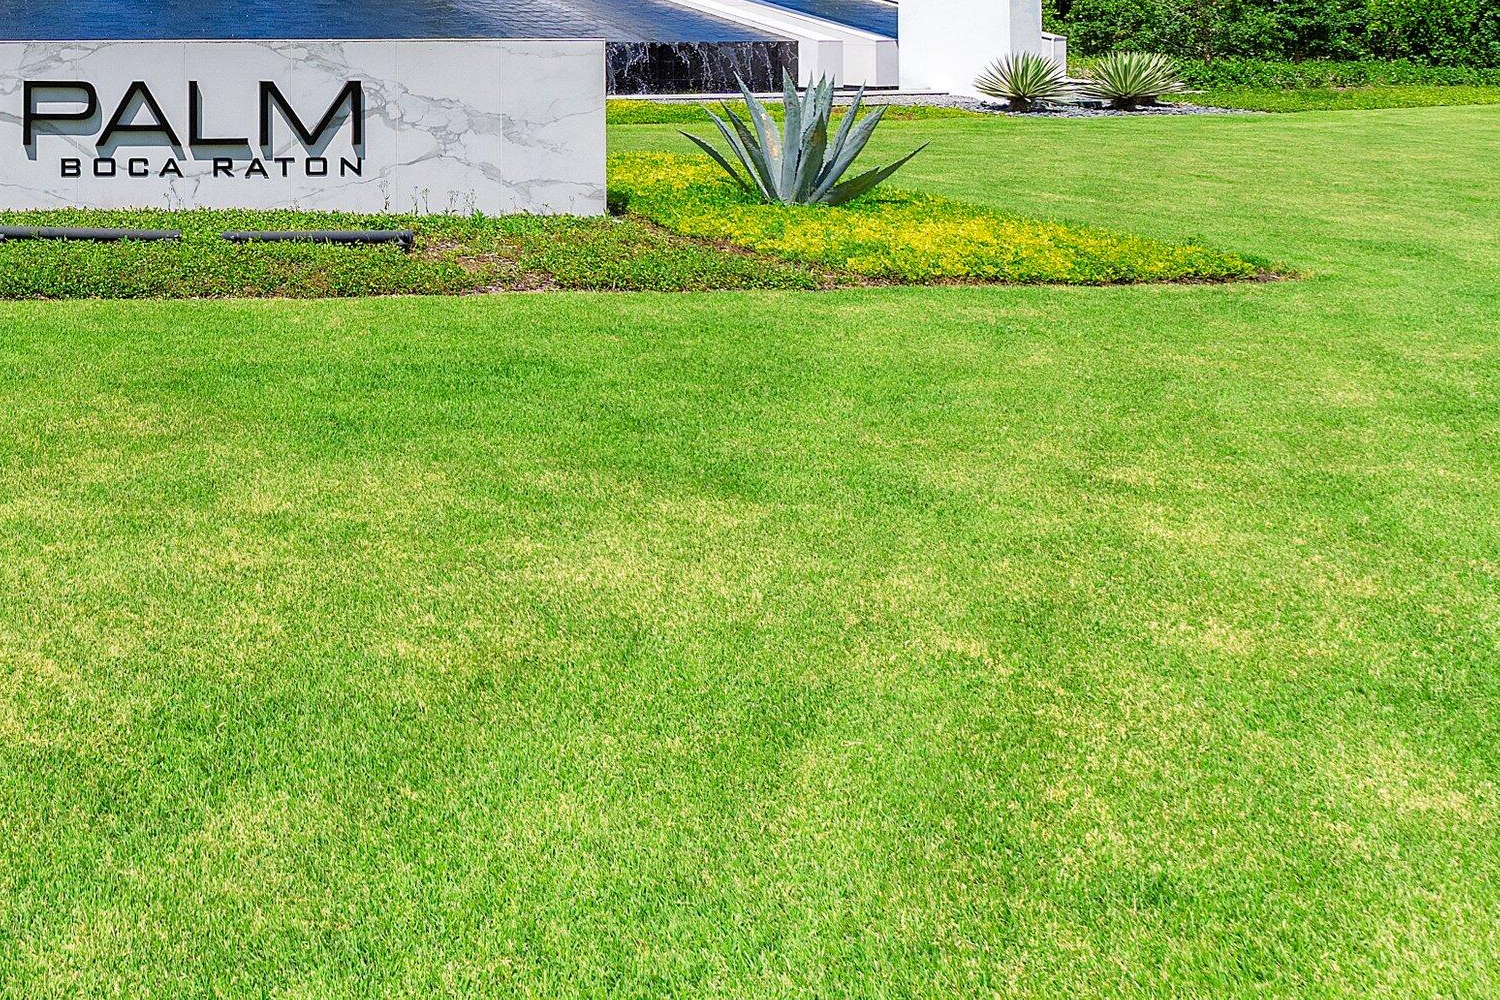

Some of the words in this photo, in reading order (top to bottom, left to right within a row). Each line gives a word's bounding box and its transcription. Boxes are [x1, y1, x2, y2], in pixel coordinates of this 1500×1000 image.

[23, 80, 362, 147] PALM
[61, 157, 184, 178] BOCA
[213, 157, 363, 178] RATON
